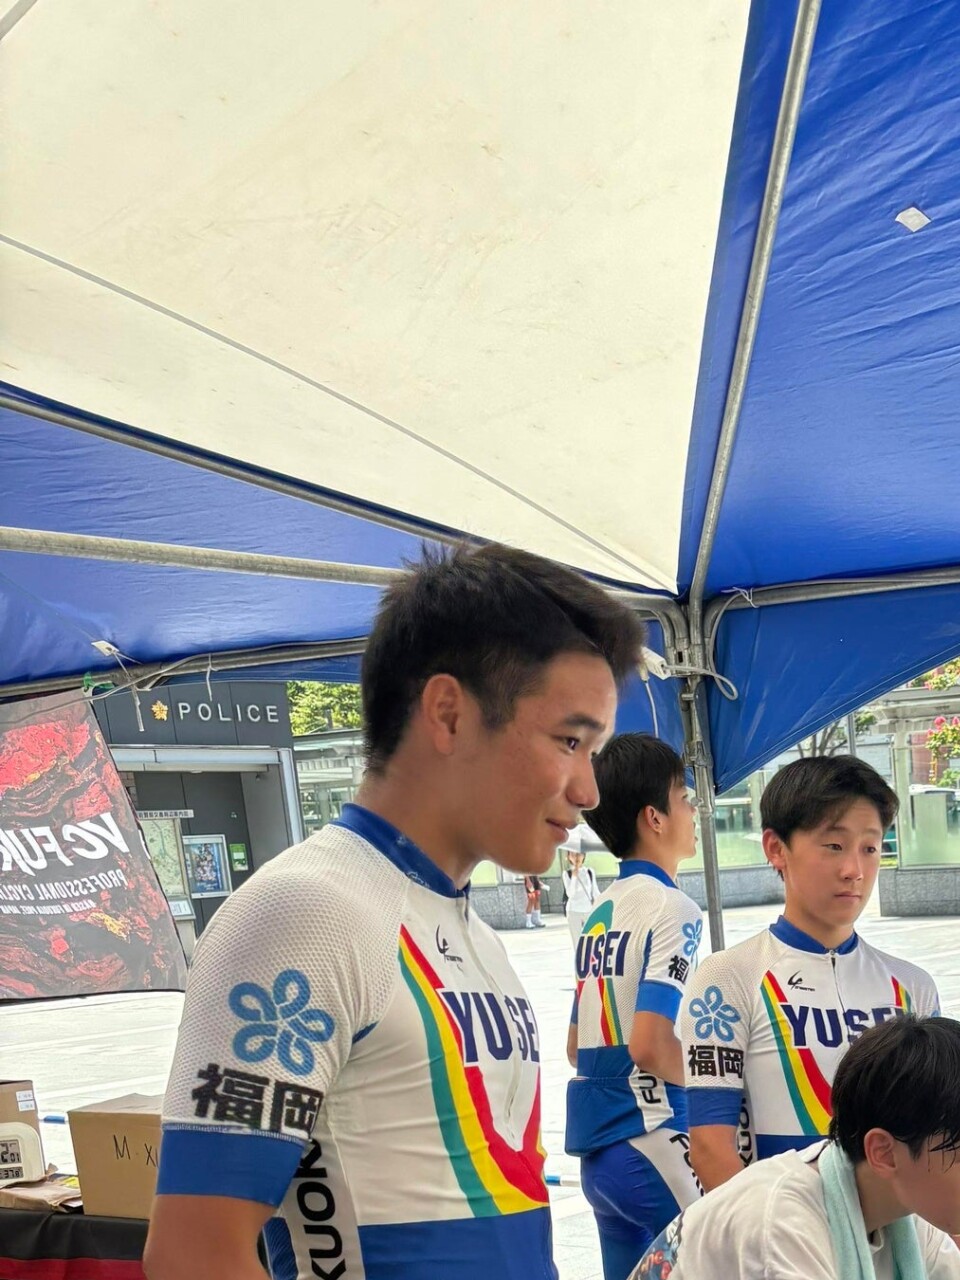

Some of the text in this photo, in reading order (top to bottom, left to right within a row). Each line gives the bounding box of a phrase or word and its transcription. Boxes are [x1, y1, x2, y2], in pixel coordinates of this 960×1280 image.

[178, 702, 279, 723] POLICE
[688, 1045, 744, 1079] 福岡
[191, 1063, 324, 1138] 福岡
[113, 1134, 131, 1160] M
